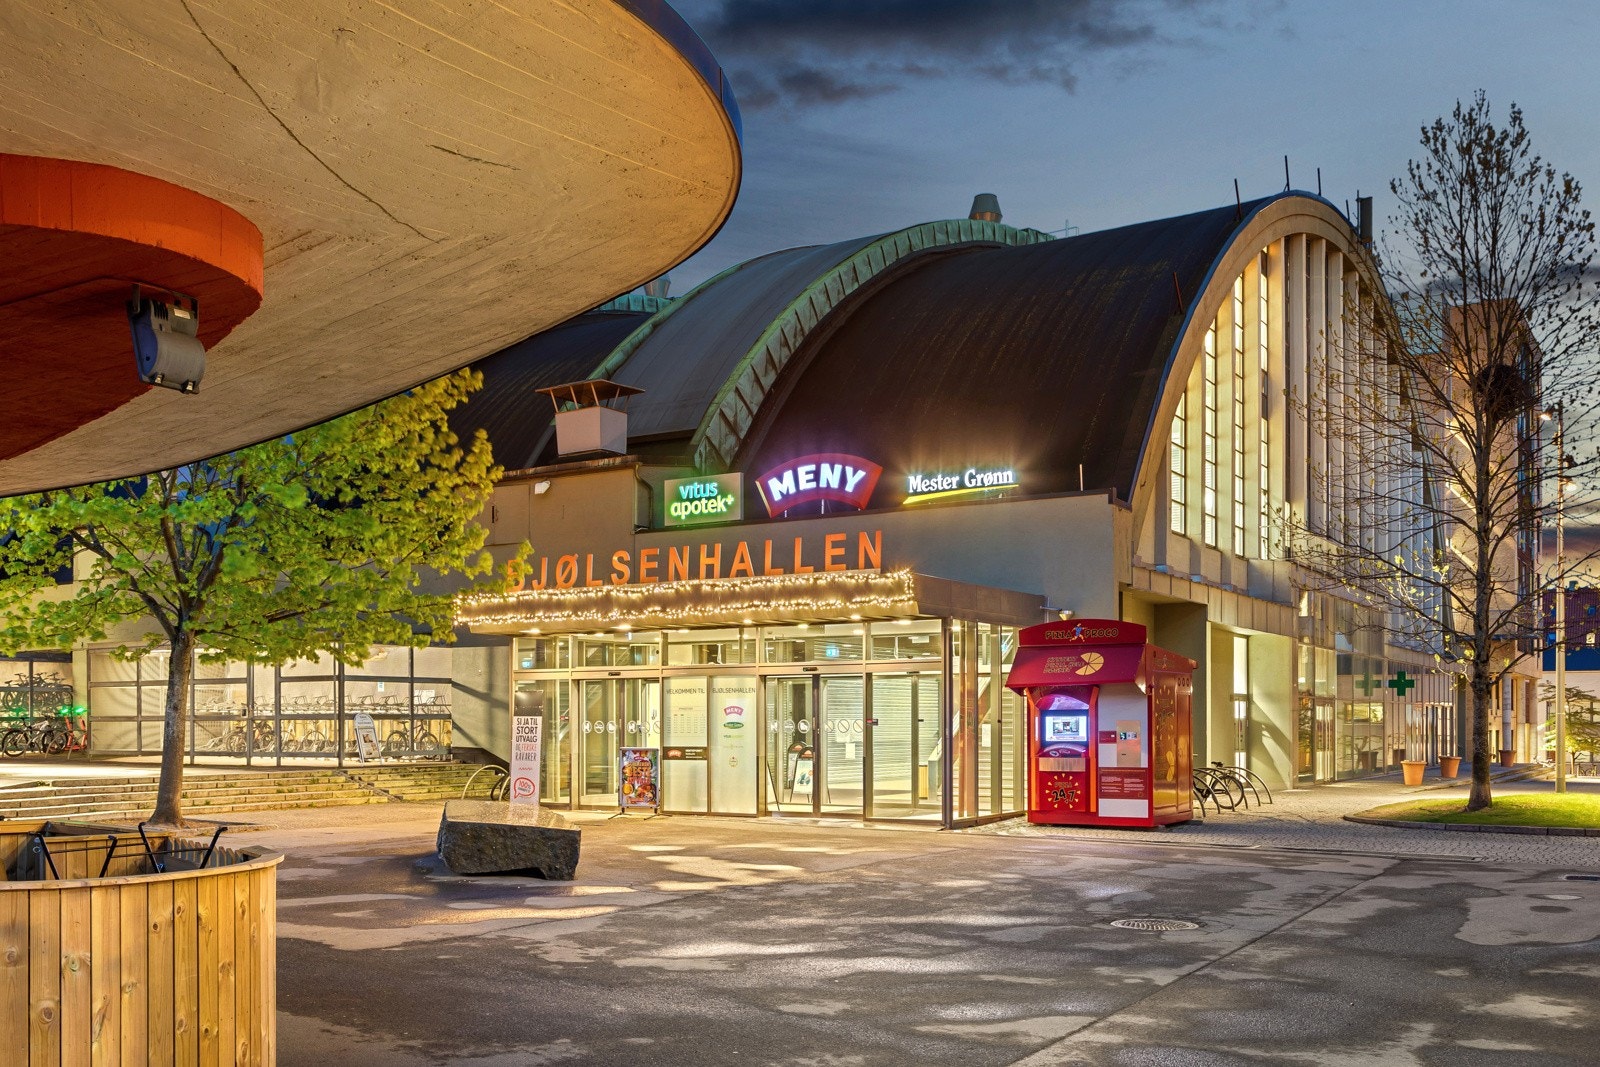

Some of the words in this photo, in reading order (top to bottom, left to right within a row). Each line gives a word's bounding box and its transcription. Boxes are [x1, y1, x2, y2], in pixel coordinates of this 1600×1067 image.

[767, 462, 867, 502] MENY
[908, 474, 960, 493] Mester
[964, 468, 1014, 487] Grønn
[679, 481, 718, 501] vitus
[1045, 630, 1073, 640] PIZZA
[1084, 627, 1119, 638] PROCO
[523, 717, 529, 726] JA
[530, 717, 538, 726] TIL
[516, 726, 538, 735] STORT
[515, 735, 538, 743] UTVALG
